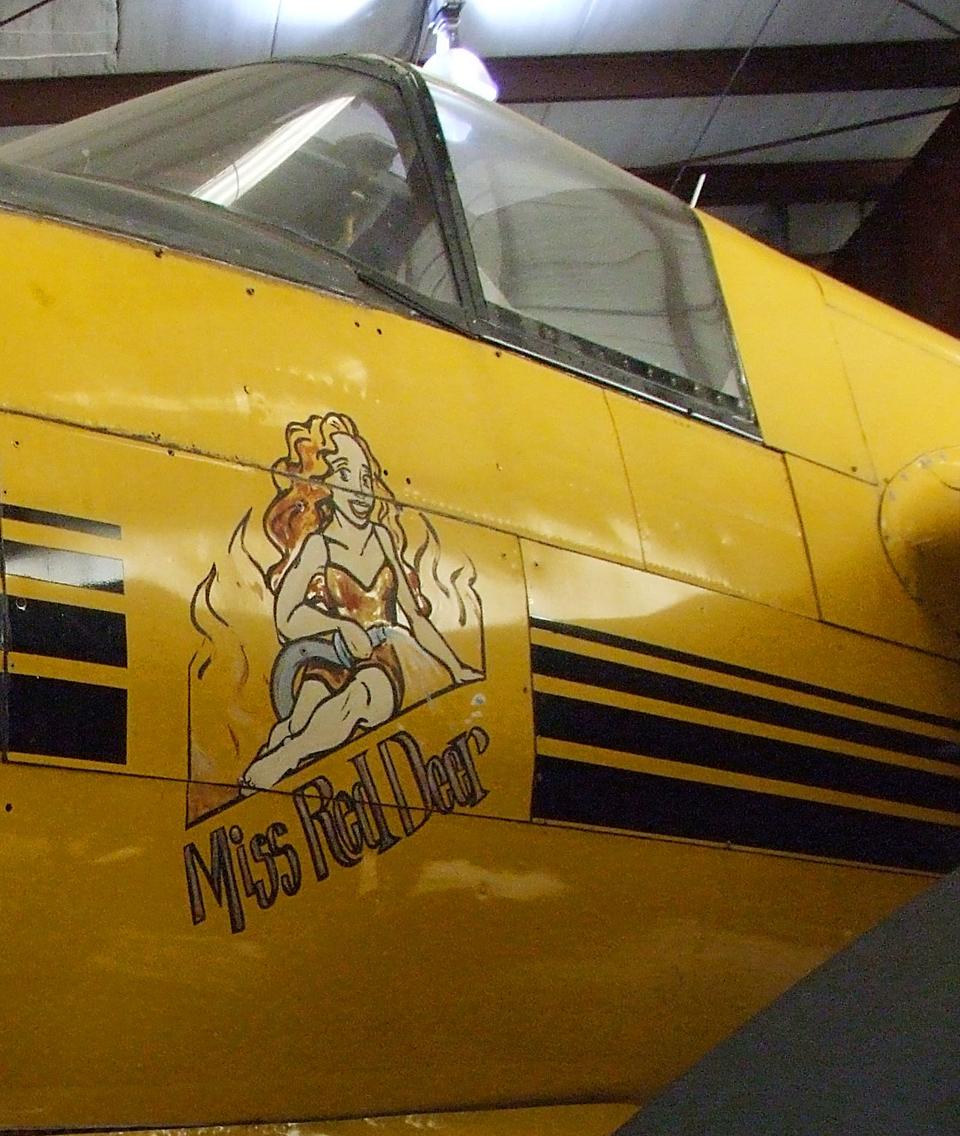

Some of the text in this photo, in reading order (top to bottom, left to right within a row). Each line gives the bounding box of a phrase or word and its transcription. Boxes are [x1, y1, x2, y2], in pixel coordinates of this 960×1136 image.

[183, 726, 490, 934] Miss Red Deer
